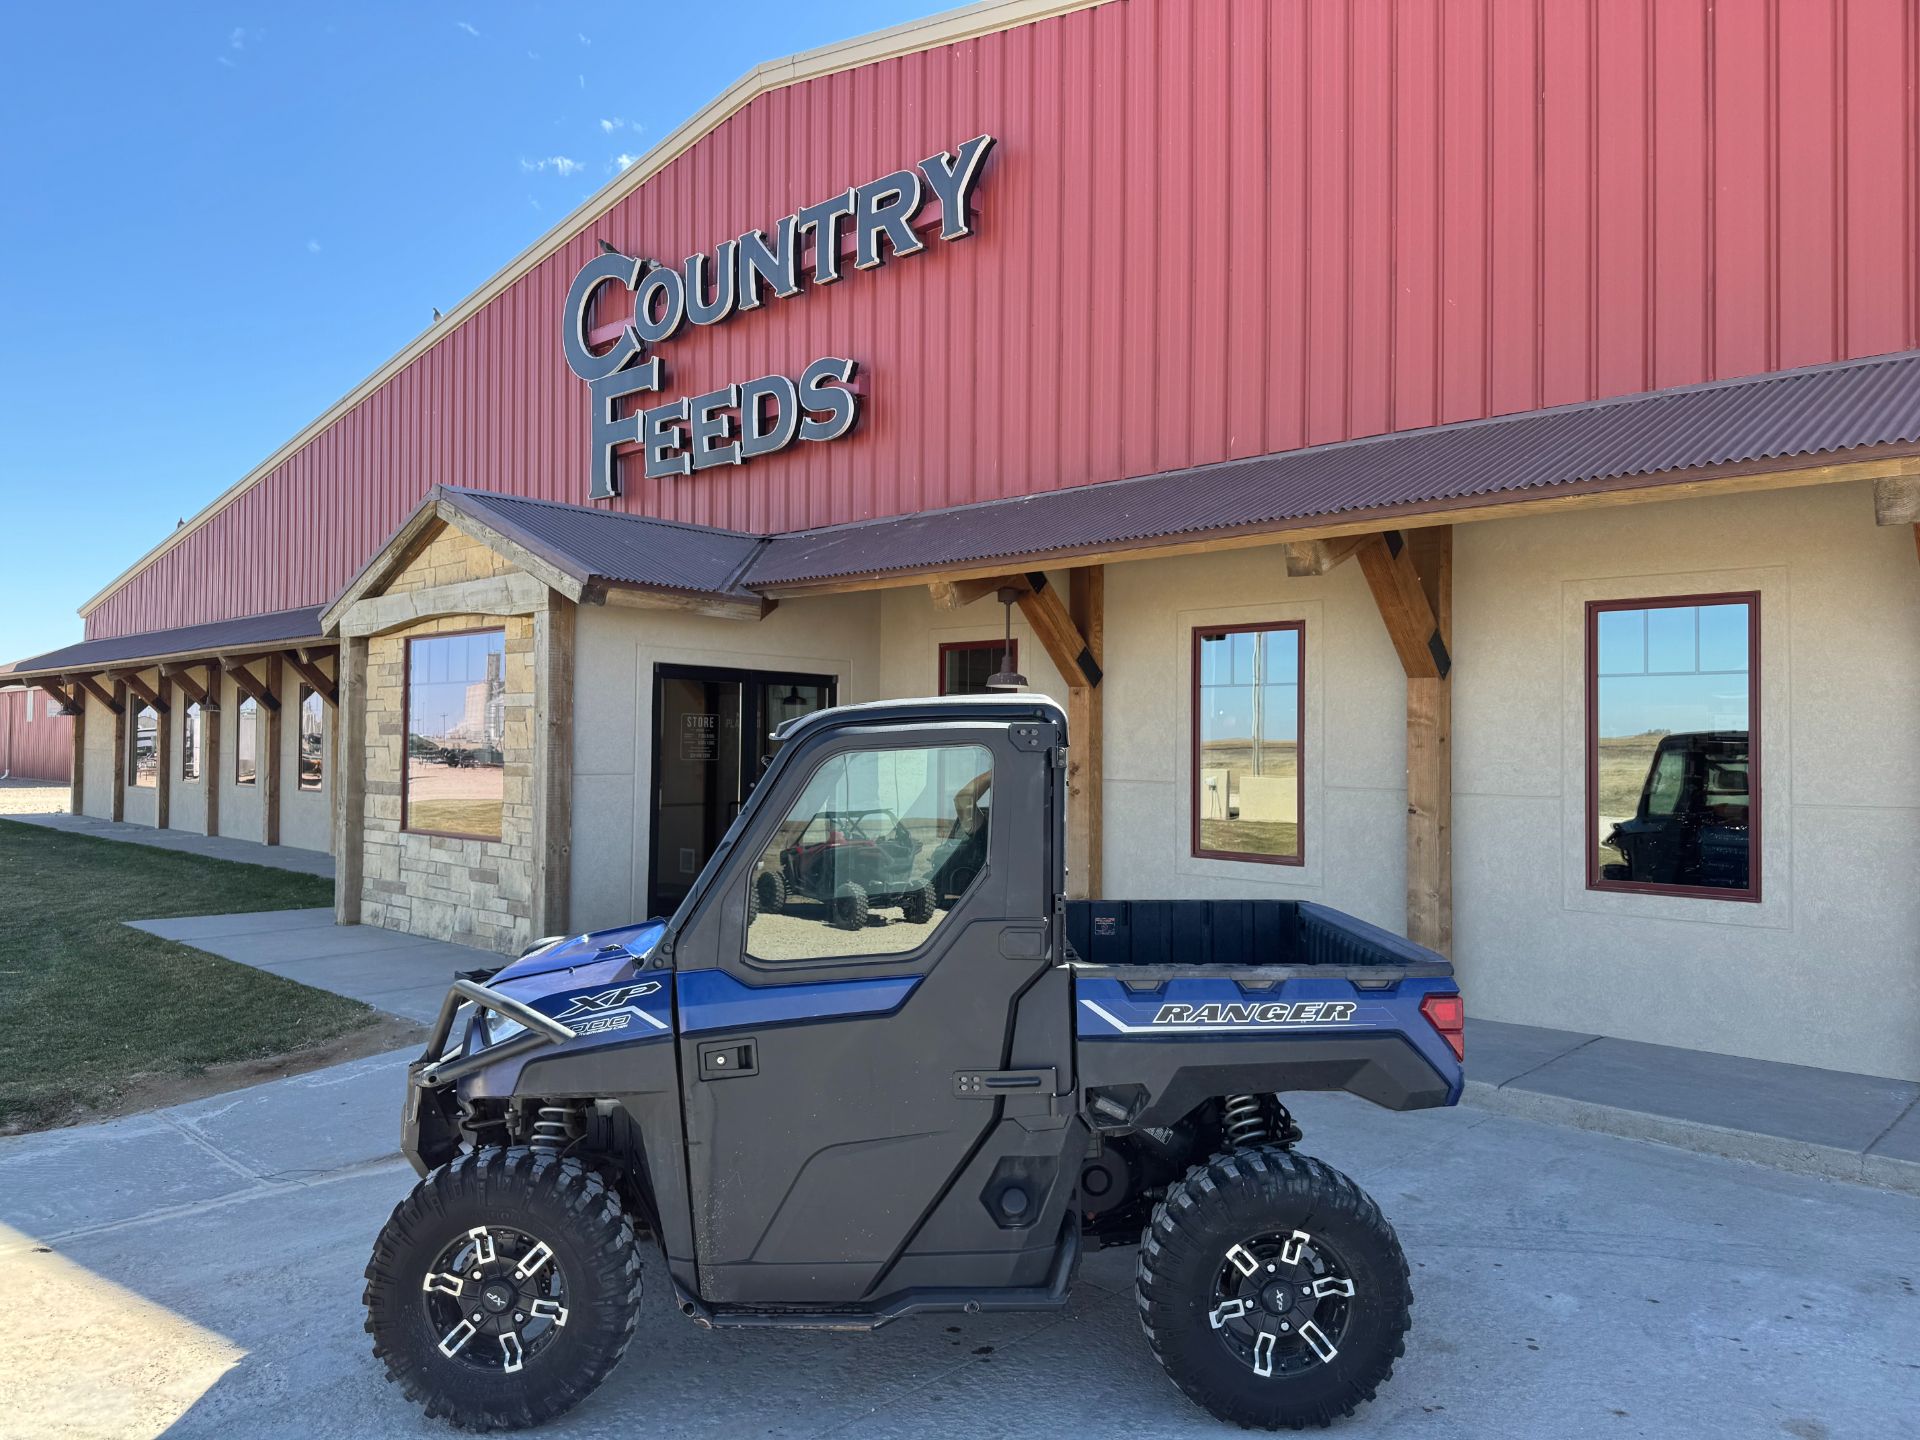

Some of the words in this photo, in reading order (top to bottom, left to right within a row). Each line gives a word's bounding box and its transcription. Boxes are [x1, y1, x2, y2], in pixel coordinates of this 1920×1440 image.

[563, 134, 997, 382] COUNTRY
[588, 356, 859, 500] FEEDS
[687, 716, 714, 728] STORE
[552, 981, 662, 1020] XP
[1153, 1001, 1358, 1024] RANGER
[567, 1014, 632, 1034] 000
